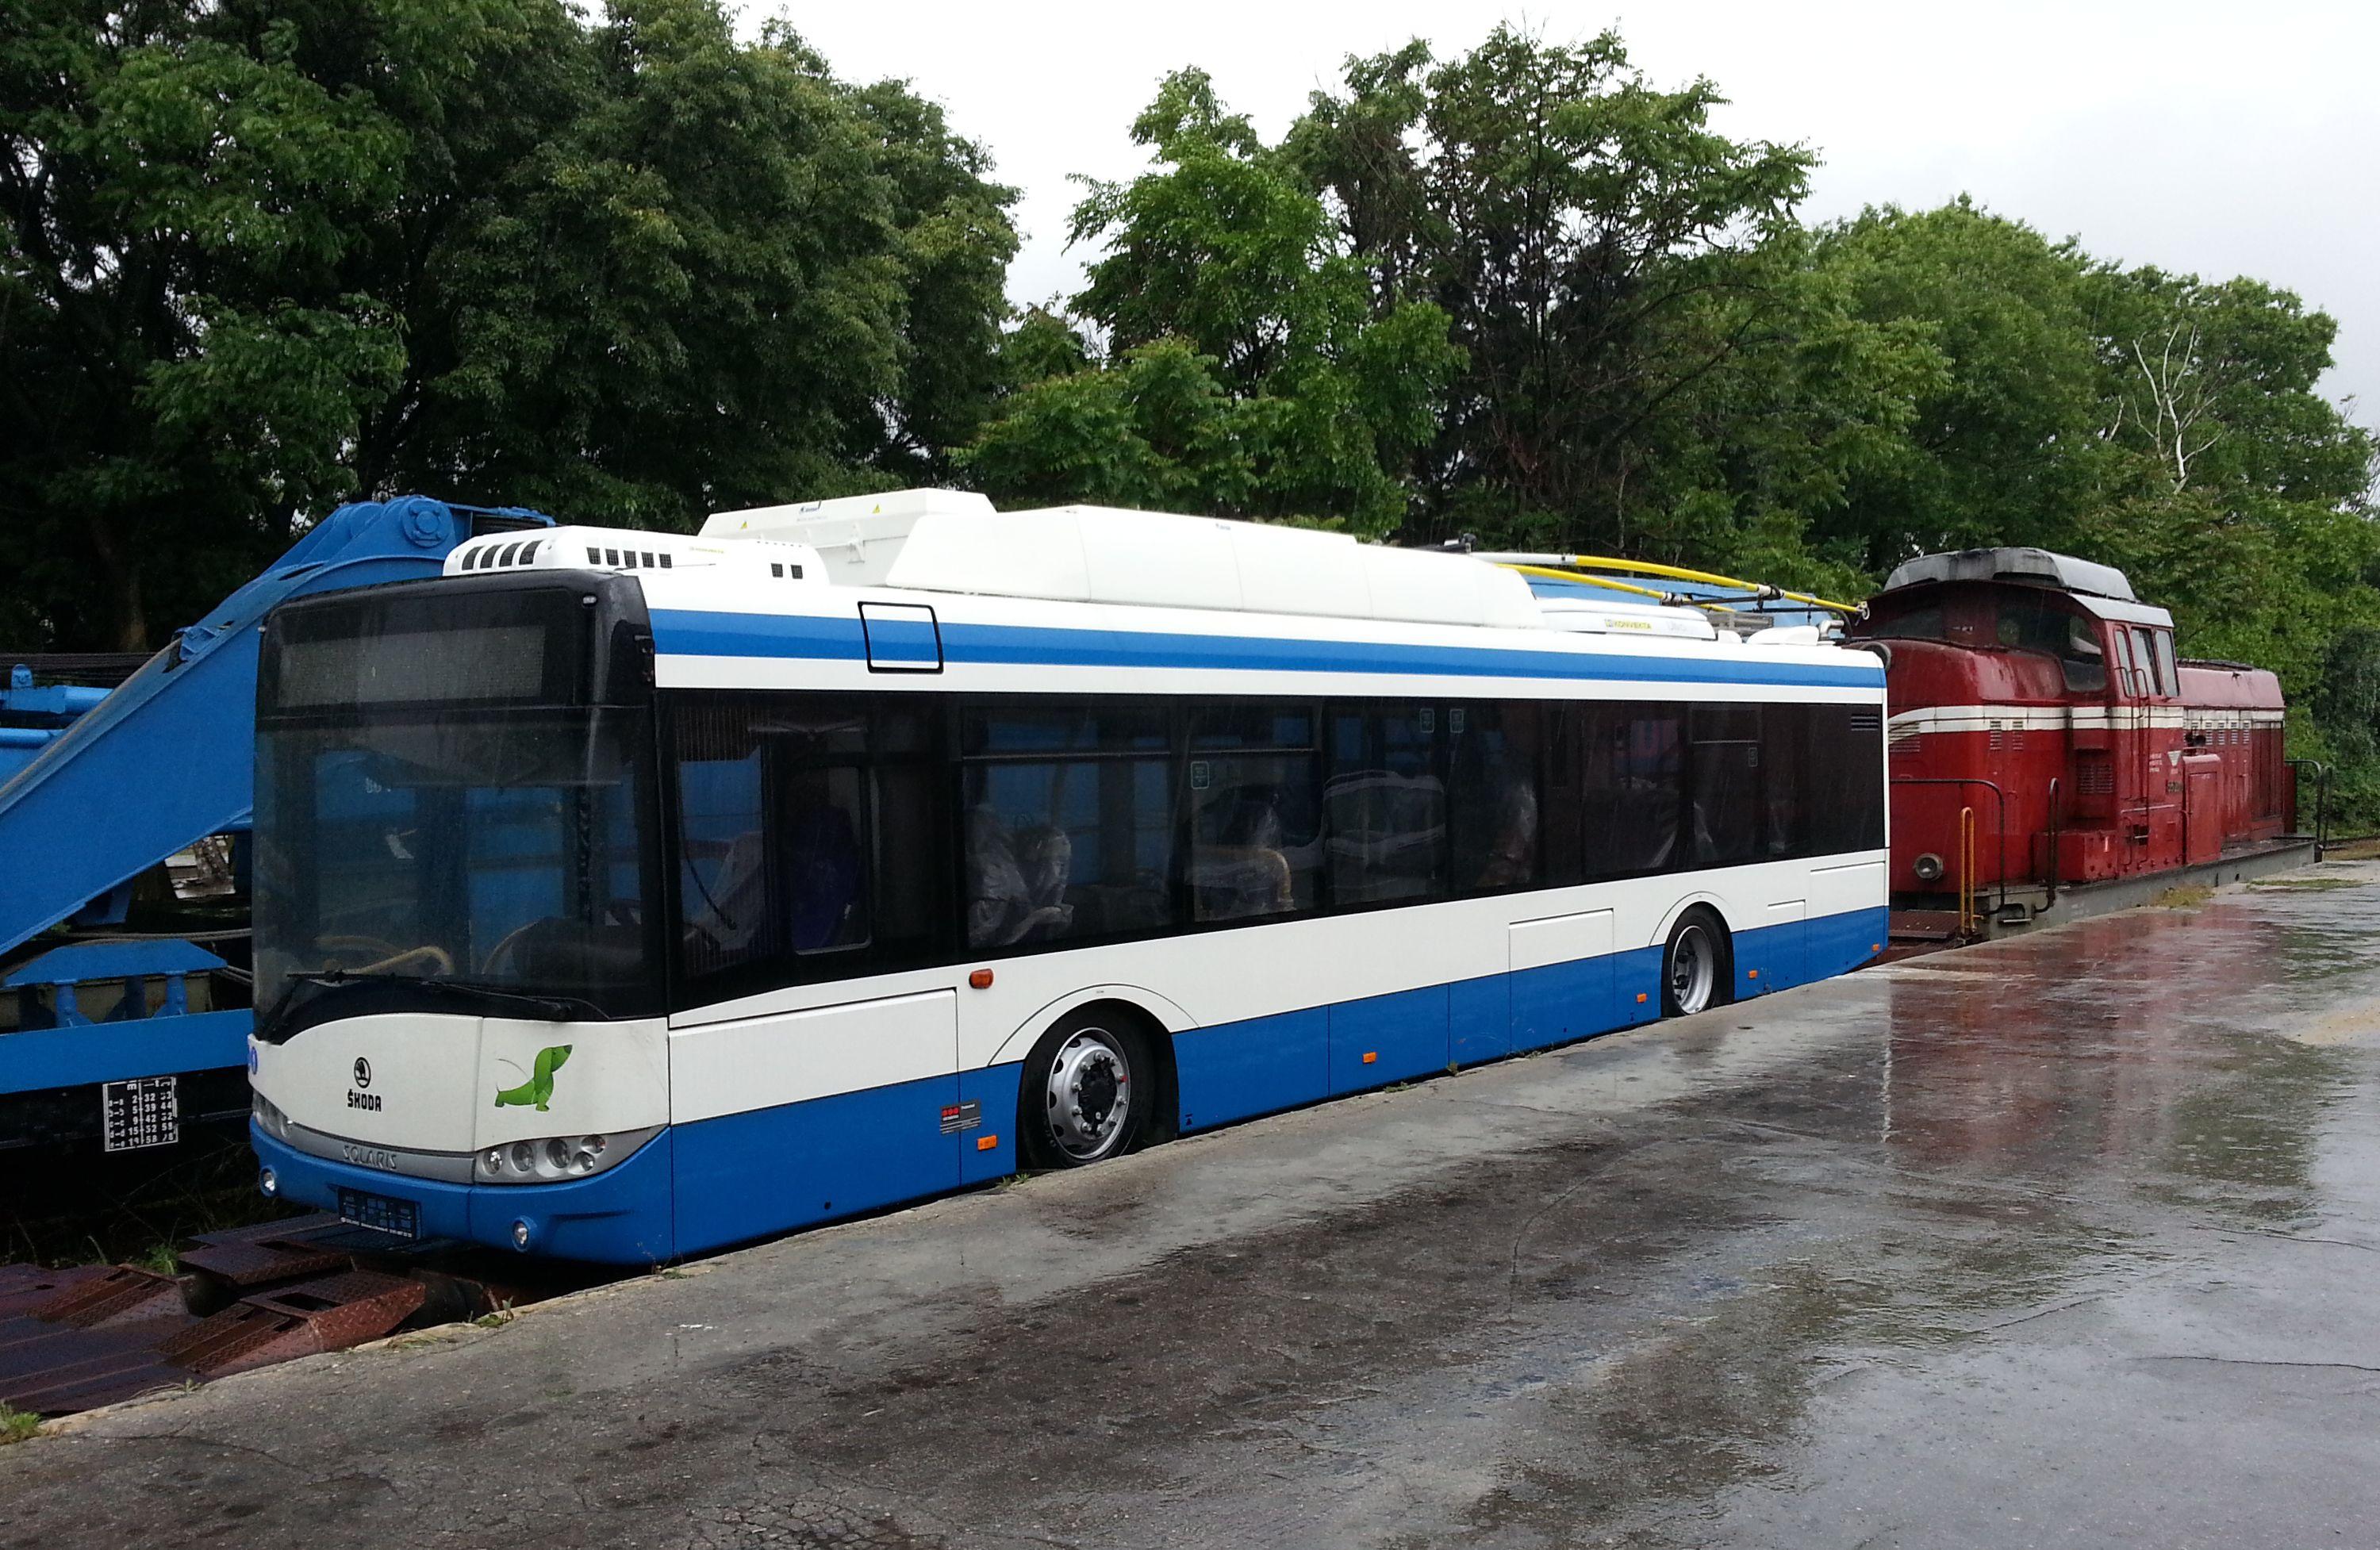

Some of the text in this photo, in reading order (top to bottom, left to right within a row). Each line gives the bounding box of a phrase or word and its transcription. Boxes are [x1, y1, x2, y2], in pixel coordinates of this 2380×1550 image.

[132, 1095, 138, 1103] 2
[144, 1093, 155, 1102] 32
[347, 1089, 382, 1112] ŠKODA
[132, 1106, 138, 1115] 5
[144, 1103, 156, 1112] 39
[160, 1101, 172, 1110] 44
[132, 1116, 139, 1125] 9
[145, 1114, 157, 1123] 42
[128, 1126, 139, 1136] 15
[145, 1125, 157, 1134] 52
[145, 1135, 157, 1144] 58
[344, 1145, 397, 1171] SOLARIS
